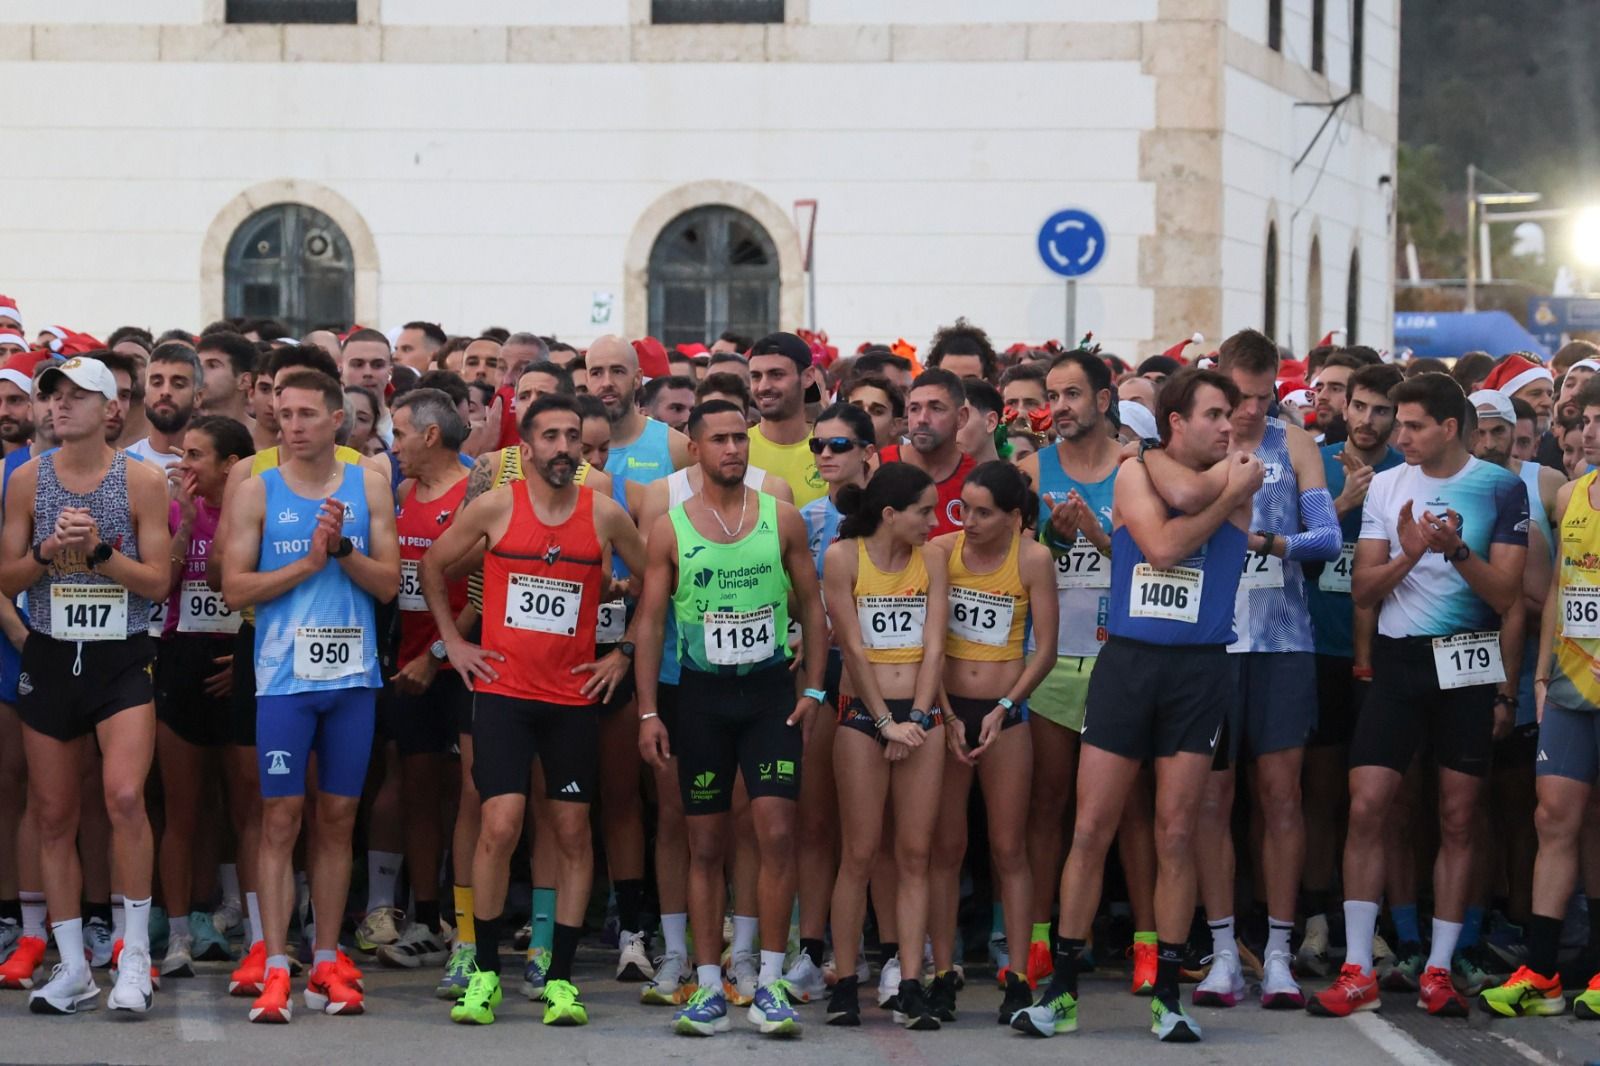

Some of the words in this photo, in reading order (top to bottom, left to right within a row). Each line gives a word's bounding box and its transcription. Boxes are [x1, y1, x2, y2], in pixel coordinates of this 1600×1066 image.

[718, 563, 772, 578] Fundación
[1058, 552, 1101, 573] 972
[718, 577, 759, 589] Unicaja
[190, 596, 232, 617] 963
[520, 591, 566, 617] 306
[1140, 582, 1189, 609] 1406
[64, 604, 112, 627] 1417
[872, 611, 912, 633] 612
[954, 603, 997, 629] 613
[1566, 600, 1598, 622] 836
[712, 623, 769, 649] 1184
[310, 642, 350, 664] 950
[1450, 647, 1490, 671] 179
